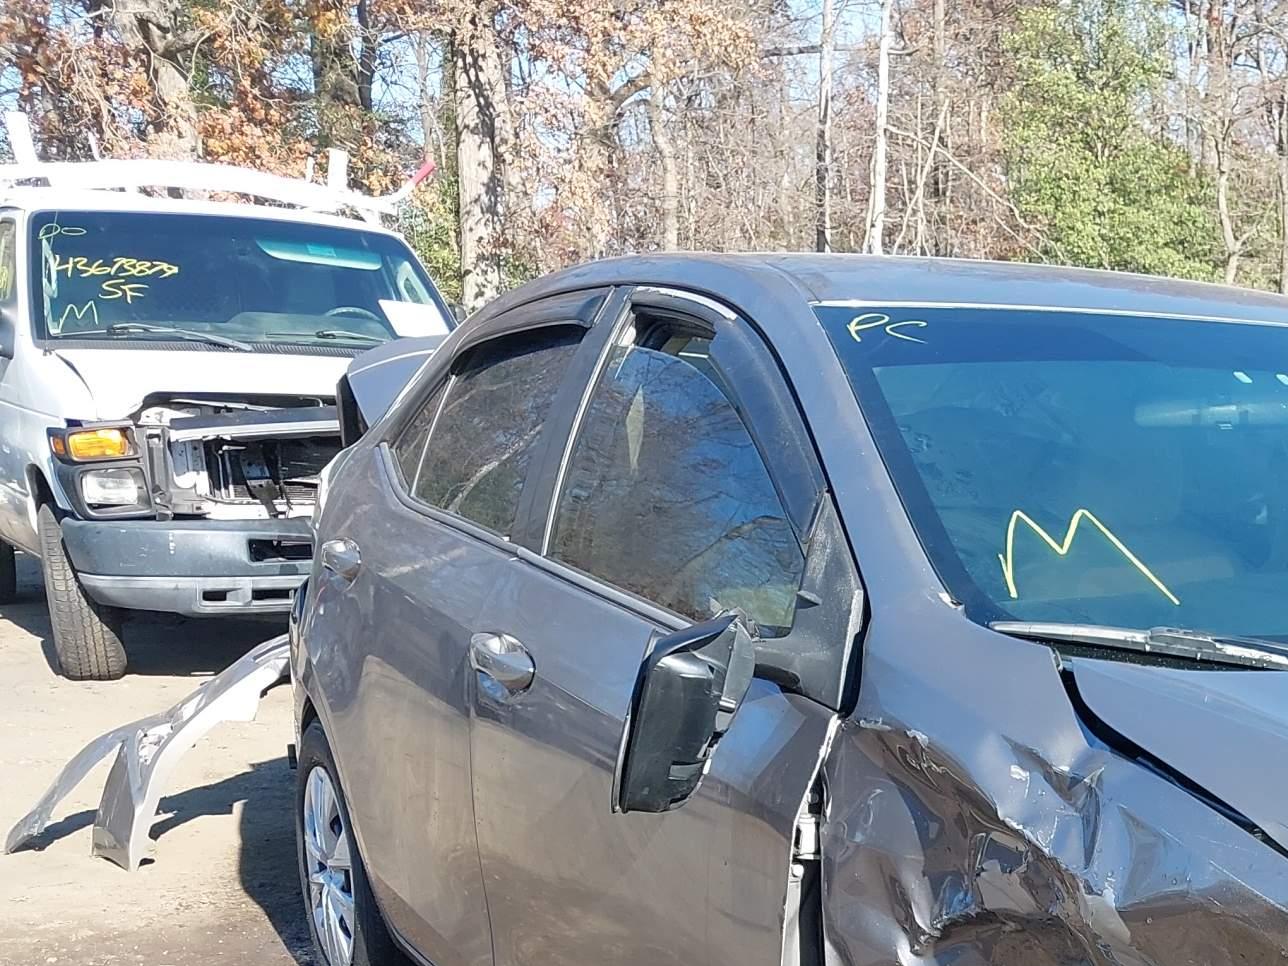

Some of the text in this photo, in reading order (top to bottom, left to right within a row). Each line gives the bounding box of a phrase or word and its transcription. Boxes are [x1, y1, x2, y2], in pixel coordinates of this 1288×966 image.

[98, 279, 149, 304] SF
[58, 300, 98, 333] M
[846, 312, 928, 344] PC
[998, 508, 1180, 605] M
